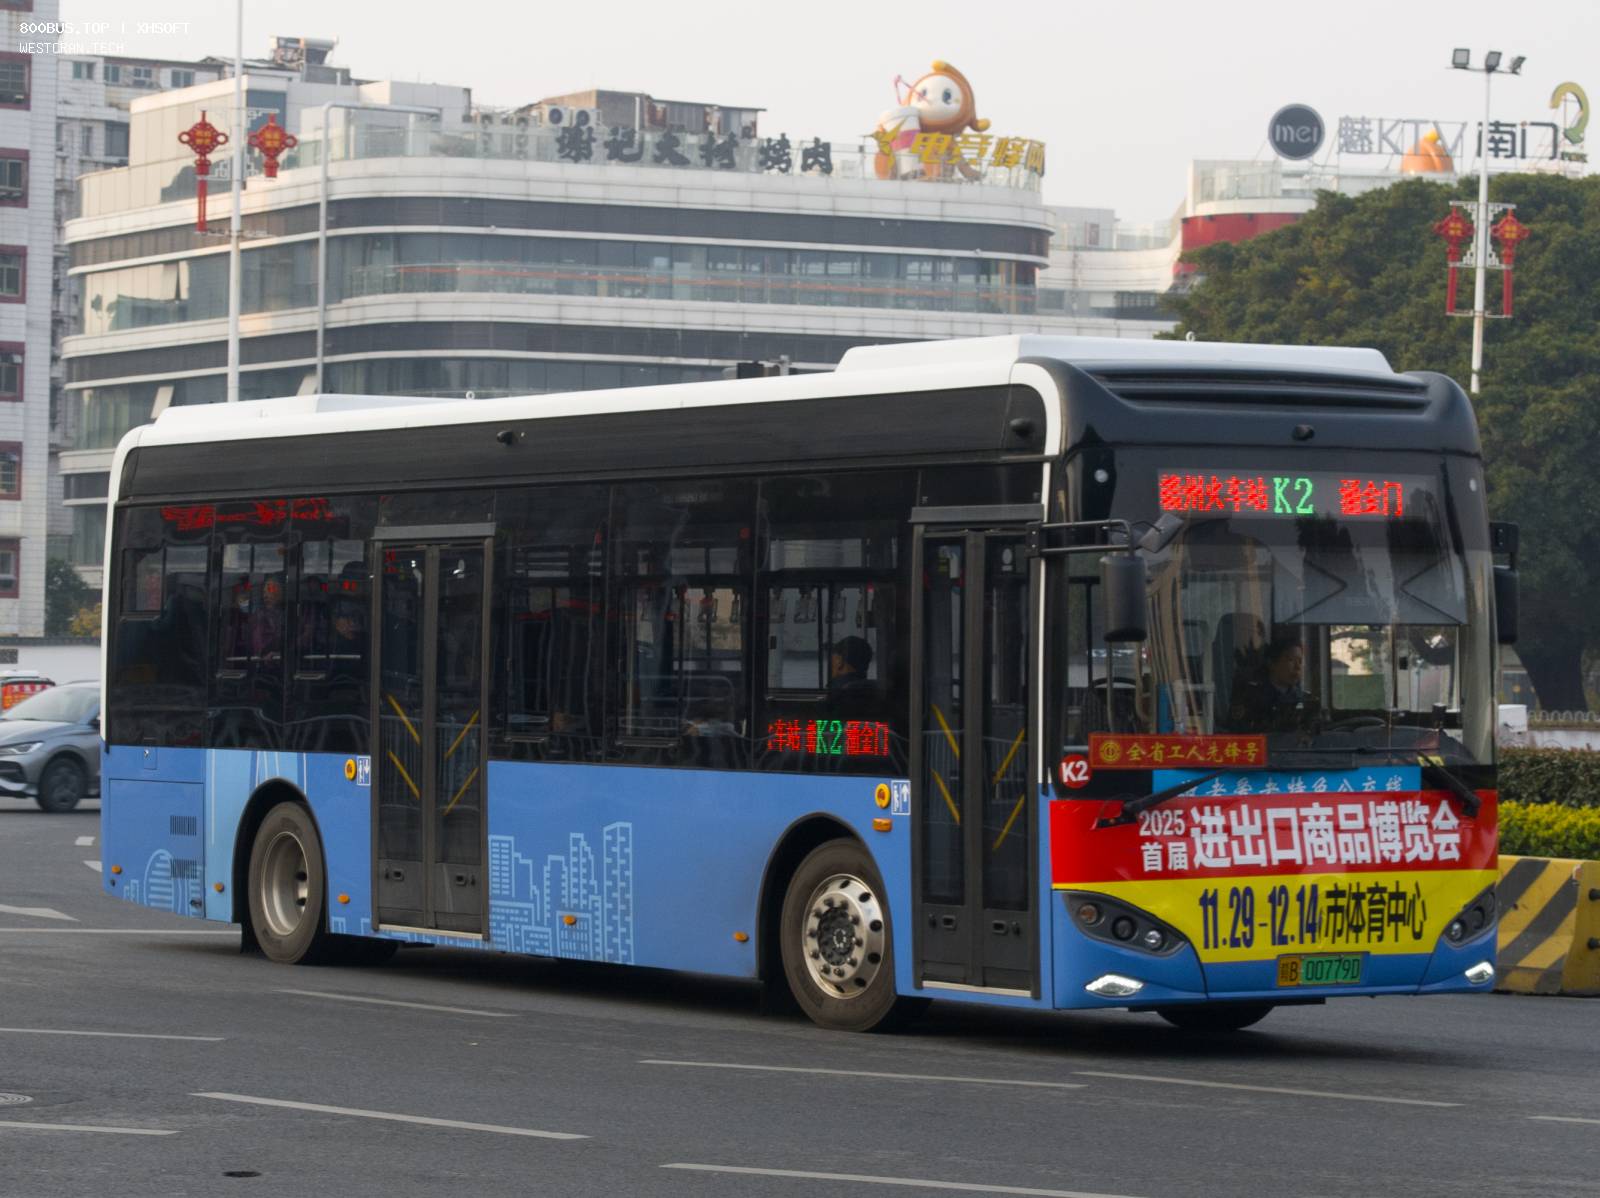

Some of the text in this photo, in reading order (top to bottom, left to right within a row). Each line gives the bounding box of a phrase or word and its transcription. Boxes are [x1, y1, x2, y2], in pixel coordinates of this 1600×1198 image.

[1275, 124, 1318, 143] mei
[1272, 477, 1314, 514] K2
[768, 719, 800, 753] 车站
[816, 719, 843, 755] K2
[1061, 760, 1089, 783] K2
[1138, 809, 1186, 837] 2025
[1189, 799, 1461, 869] 进出口商品博览会
[1141, 842, 1189, 873] 首届
